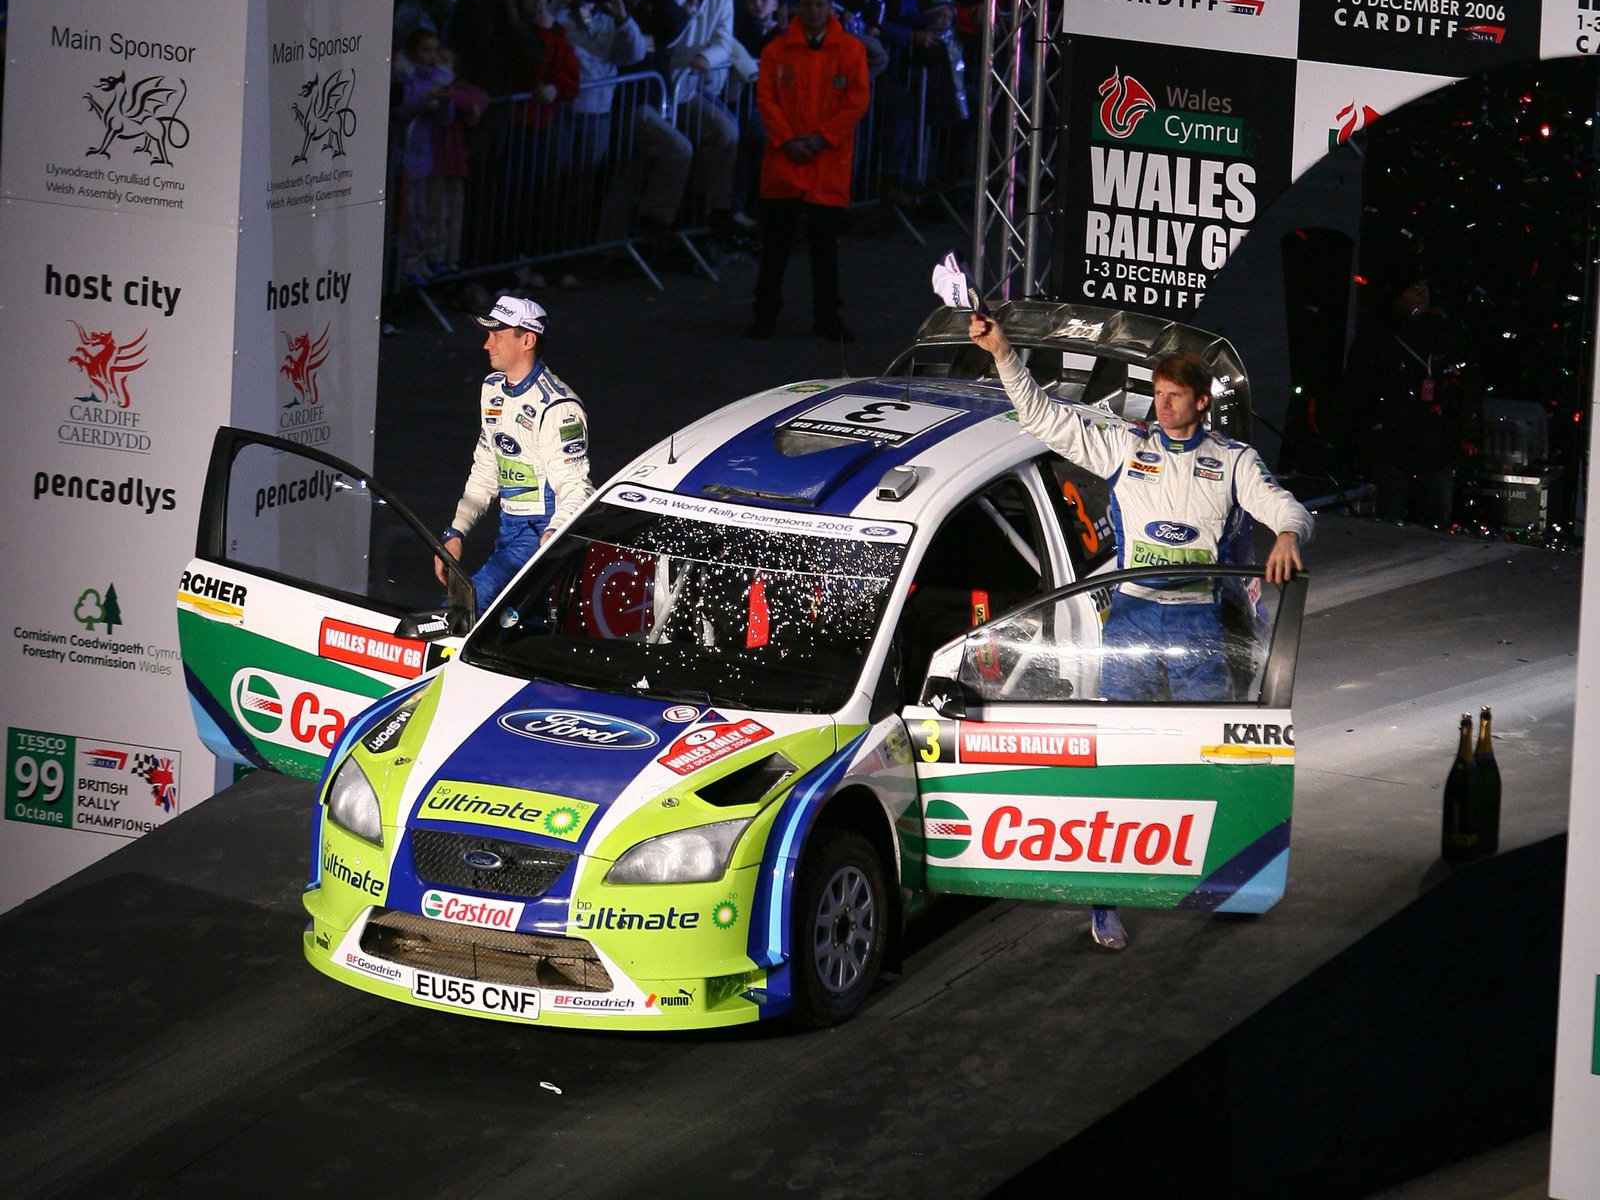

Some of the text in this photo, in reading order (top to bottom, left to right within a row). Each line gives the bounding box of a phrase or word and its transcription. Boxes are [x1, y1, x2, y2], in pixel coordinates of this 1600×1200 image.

[1334, 8, 1458, 38] CARDIFF
[1464, 2, 1506, 22] 2006
[51, 25, 196, 64] Main Sponsor
[272, 34, 362, 65] Main Sponsor
[1166, 86, 1232, 114] Wales
[1164, 115, 1239, 144] Cymru
[46, 181, 184, 210] Welsh Assembly Government
[153, 176, 185, 192] Cymru
[1090, 146, 1257, 224] WALES
[1085, 210, 1195, 267] RALLY
[1084, 259, 1207, 289] 1-3 DECEMBER
[45, 264, 182, 317] host city
[267, 269, 352, 311] host city
[1082, 280, 1206, 309] CARDIFF
[69, 404, 141, 428] CARDIFF
[280, 405, 325, 429] CARDIFF
[845, 402, 911, 424] 3
[57, 424, 151, 451] CAERDYDD
[811, 422, 851, 434] RALLY
[853, 427, 903, 441] WALES
[34, 471, 177, 515] pencadlys
[649, 497, 668, 506] FIA
[671, 501, 707, 513] World
[708, 507, 738, 519] Rally
[740, 512, 813, 528] Champions
[816, 521, 854, 532] 2006
[1155, 524, 1188, 541] Ford
[417, 621, 445, 634] PUMA
[14, 626, 181, 661] Comisiwn Coedwigaeth Cymru
[325, 628, 365, 654] WALES
[367, 638, 403, 663] RALLY
[403, 648, 422, 668] GB
[23, 644, 172, 676] Forestry Commission Wales
[674, 708, 691, 719] E
[17, 733, 67, 750] TESCO
[528, 712, 631, 745] Ford
[694, 734, 707, 742] 3
[919, 720, 941, 763] 3
[666, 722, 763, 769] WALES RALLY GB
[680, 738, 752, 773] 1-3 DECEMBER 2006
[965, 734, 1091, 755] WALES RALLY GB
[15, 755, 65, 802] 99
[77, 778, 128, 796] BRITISH
[437, 785, 451, 797] bp
[15, 803, 64, 823] Octane
[77, 795, 120, 812] RALLY
[428, 789, 543, 822] ultimate
[982, 805, 1195, 867] Castrol
[323, 852, 384, 898] ultimate
[444, 898, 514, 928] Castrol
[576, 907, 700, 930] ultimate
[577, 899, 592, 911] bp
[346, 953, 402, 980] BFGoodrich
[416, 973, 536, 1014] EU55 CNF
[554, 995, 635, 1009] BFGoodrich
[661, 996, 688, 1006] PUMA
